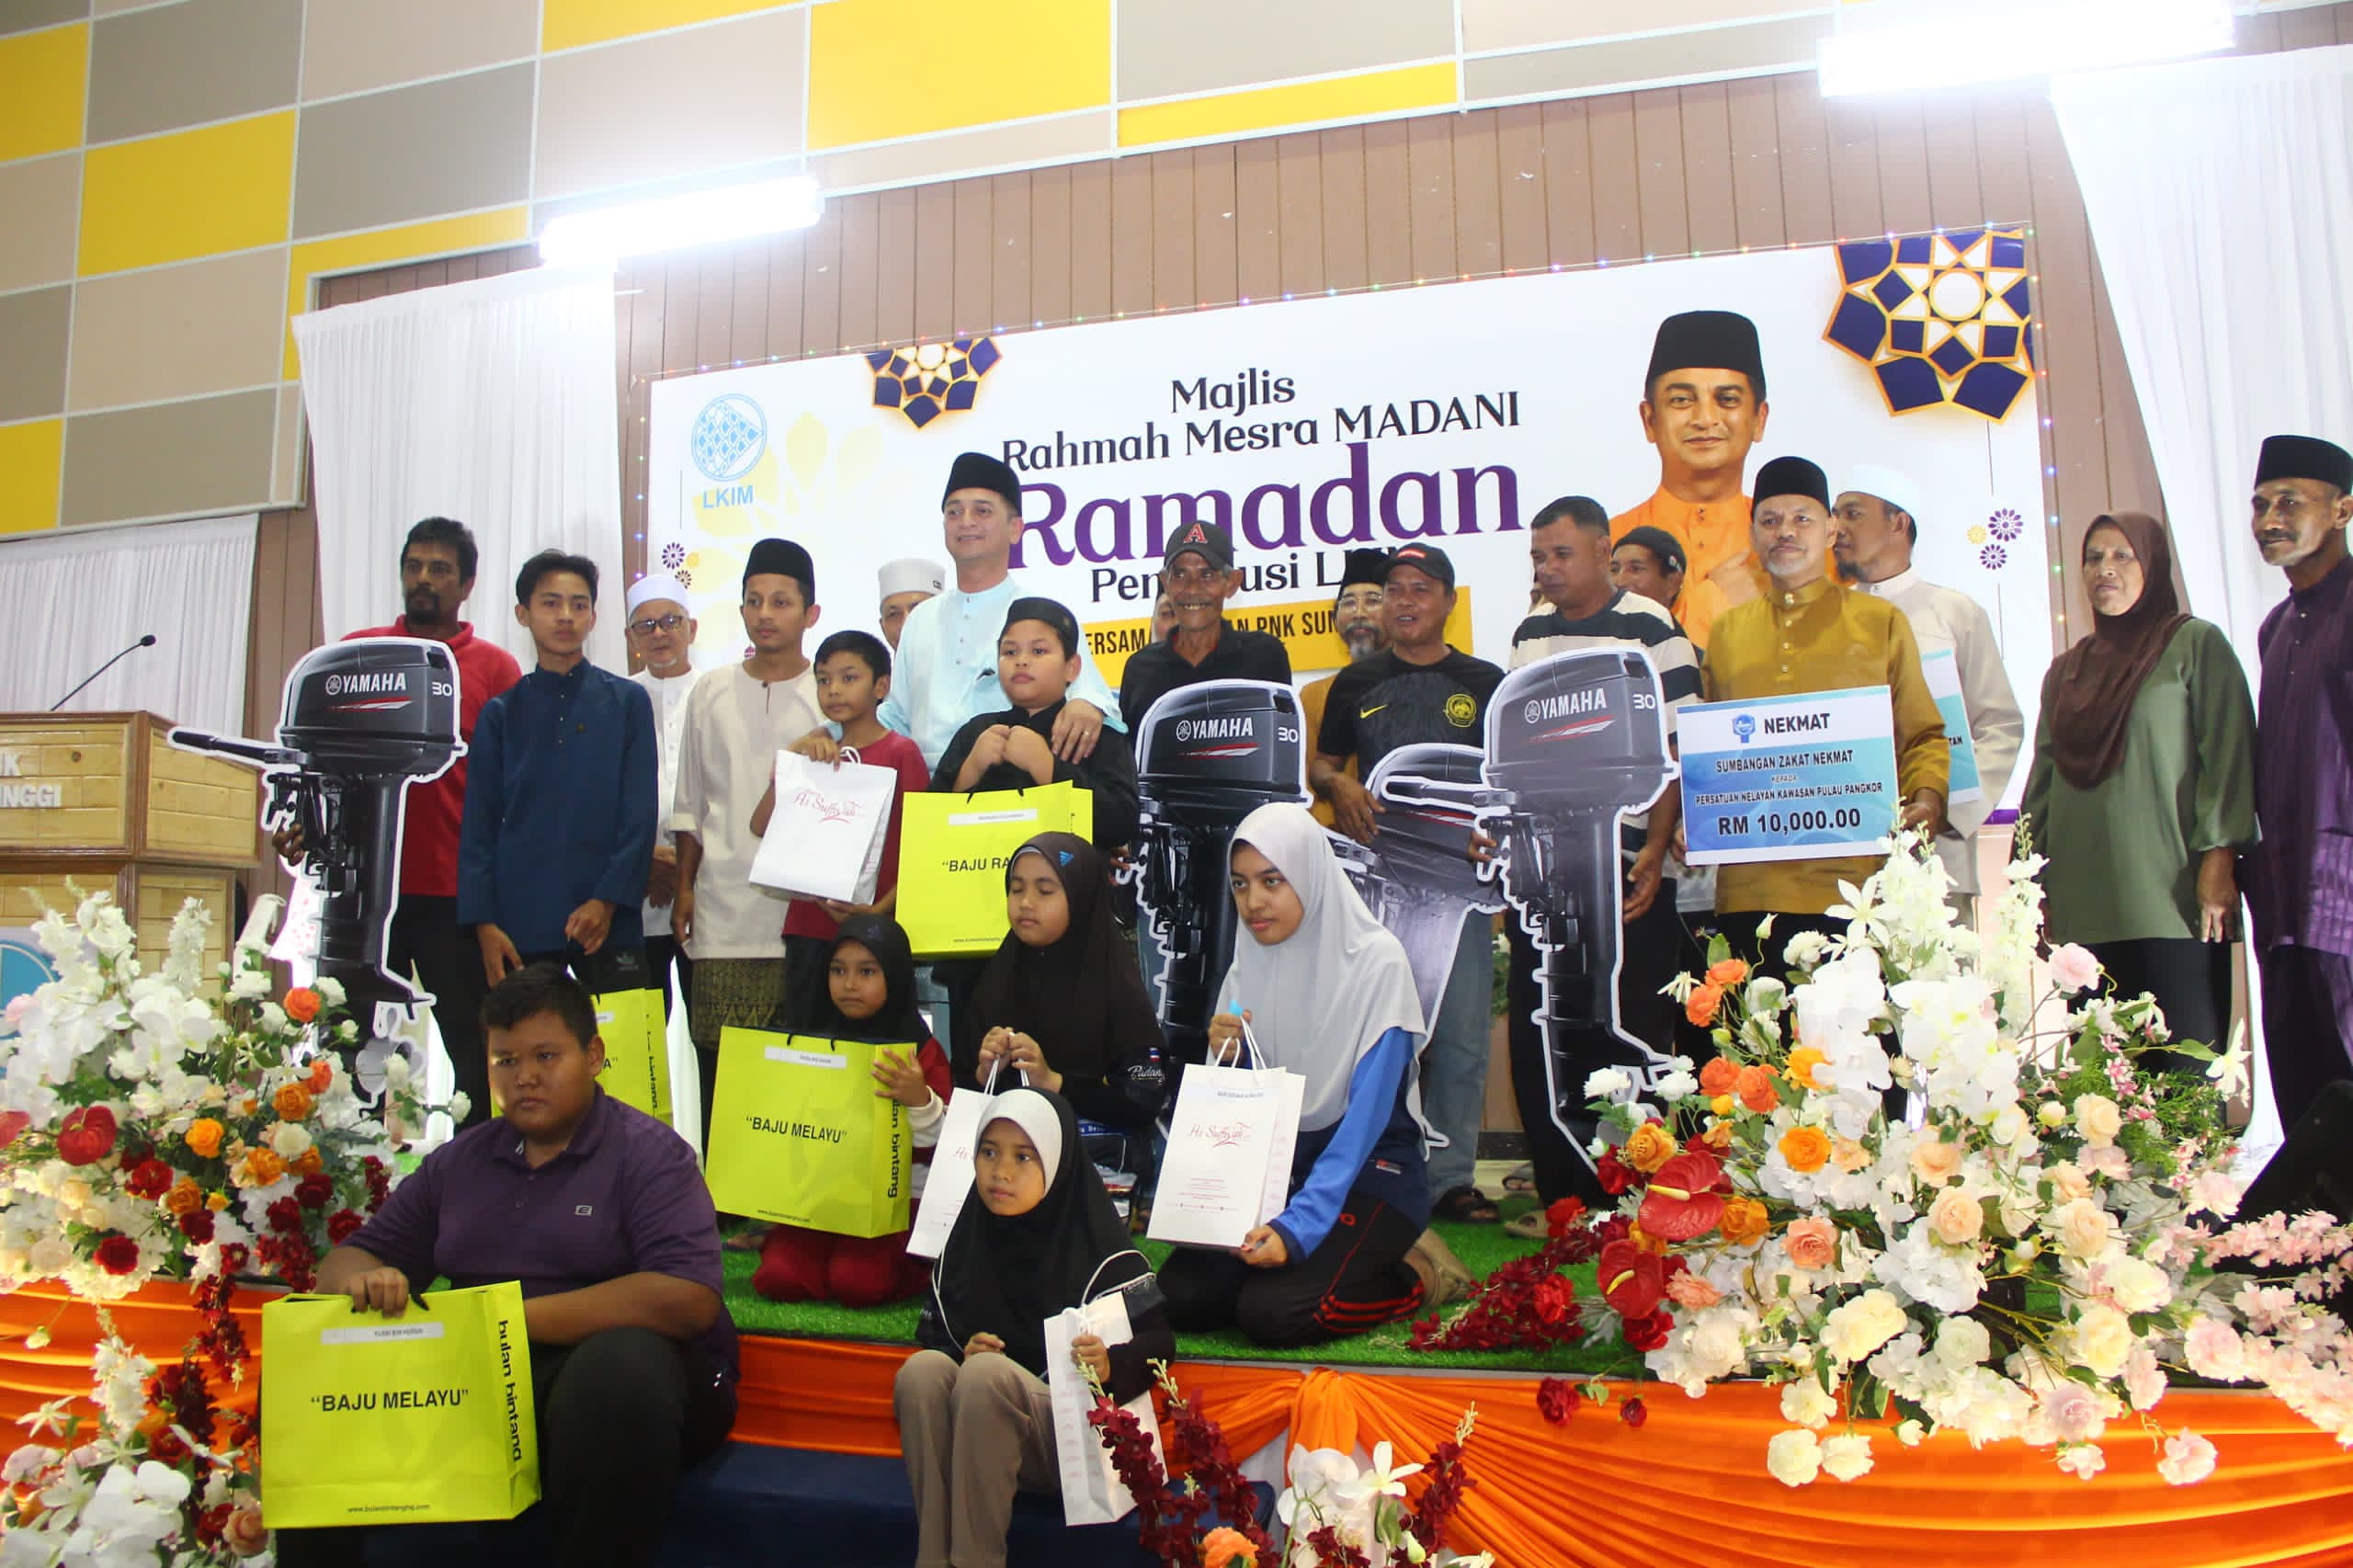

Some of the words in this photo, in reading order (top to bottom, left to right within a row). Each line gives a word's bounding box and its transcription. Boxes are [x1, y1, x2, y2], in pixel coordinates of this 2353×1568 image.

[1171, 368, 1296, 417] Majlis
[1002, 422, 1170, 472] Rahmah
[1185, 418, 1319, 456] Mesra
[1334, 392, 1521, 443] MADANI
[703, 484, 754, 508] LKIM
[1007, 442, 1526, 569] Ramadan
[1091, 551, 1301, 603] Penusi
[1256, 613, 1296, 638] PNK
[344, 672, 407, 694] YAMAHA
[431, 681, 453, 697] 30
[1540, 687, 1608, 720] YAMAHA
[1631, 693, 1656, 710] 30
[1192, 717, 1254, 740] YAMAHA
[1278, 726, 1299, 743] 30
[1764, 713, 1831, 734] NEKMAT
[1716, 756, 1776, 773] SUMBANGAN
[1779, 753, 1810, 768] ZAKAT
[1813, 749, 1854, 766] NEKMAT
[1696, 793, 1740, 806] PERSATUAN
[1742, 790, 1775, 802] NELAYAN
[1778, 788, 1815, 800] KAWASAN
[1817, 785, 1843, 797] PULAU
[1845, 782, 1883, 794] PANGKOR
[1718, 815, 1748, 835] RM
[1757, 808, 1861, 835] 10,000.00
[991, 858, 1011, 869] RA
[745, 1117, 789, 1135] “BAJU
[791, 1122, 847, 1144] MELAYU”
[887, 1133, 901, 1199] bintang
[311, 1392, 376, 1412] “BAJU
[382, 1389, 469, 1409] MELAYU”
[498, 1320, 512, 1378] bulan
[506, 1381, 523, 1462] bintang
